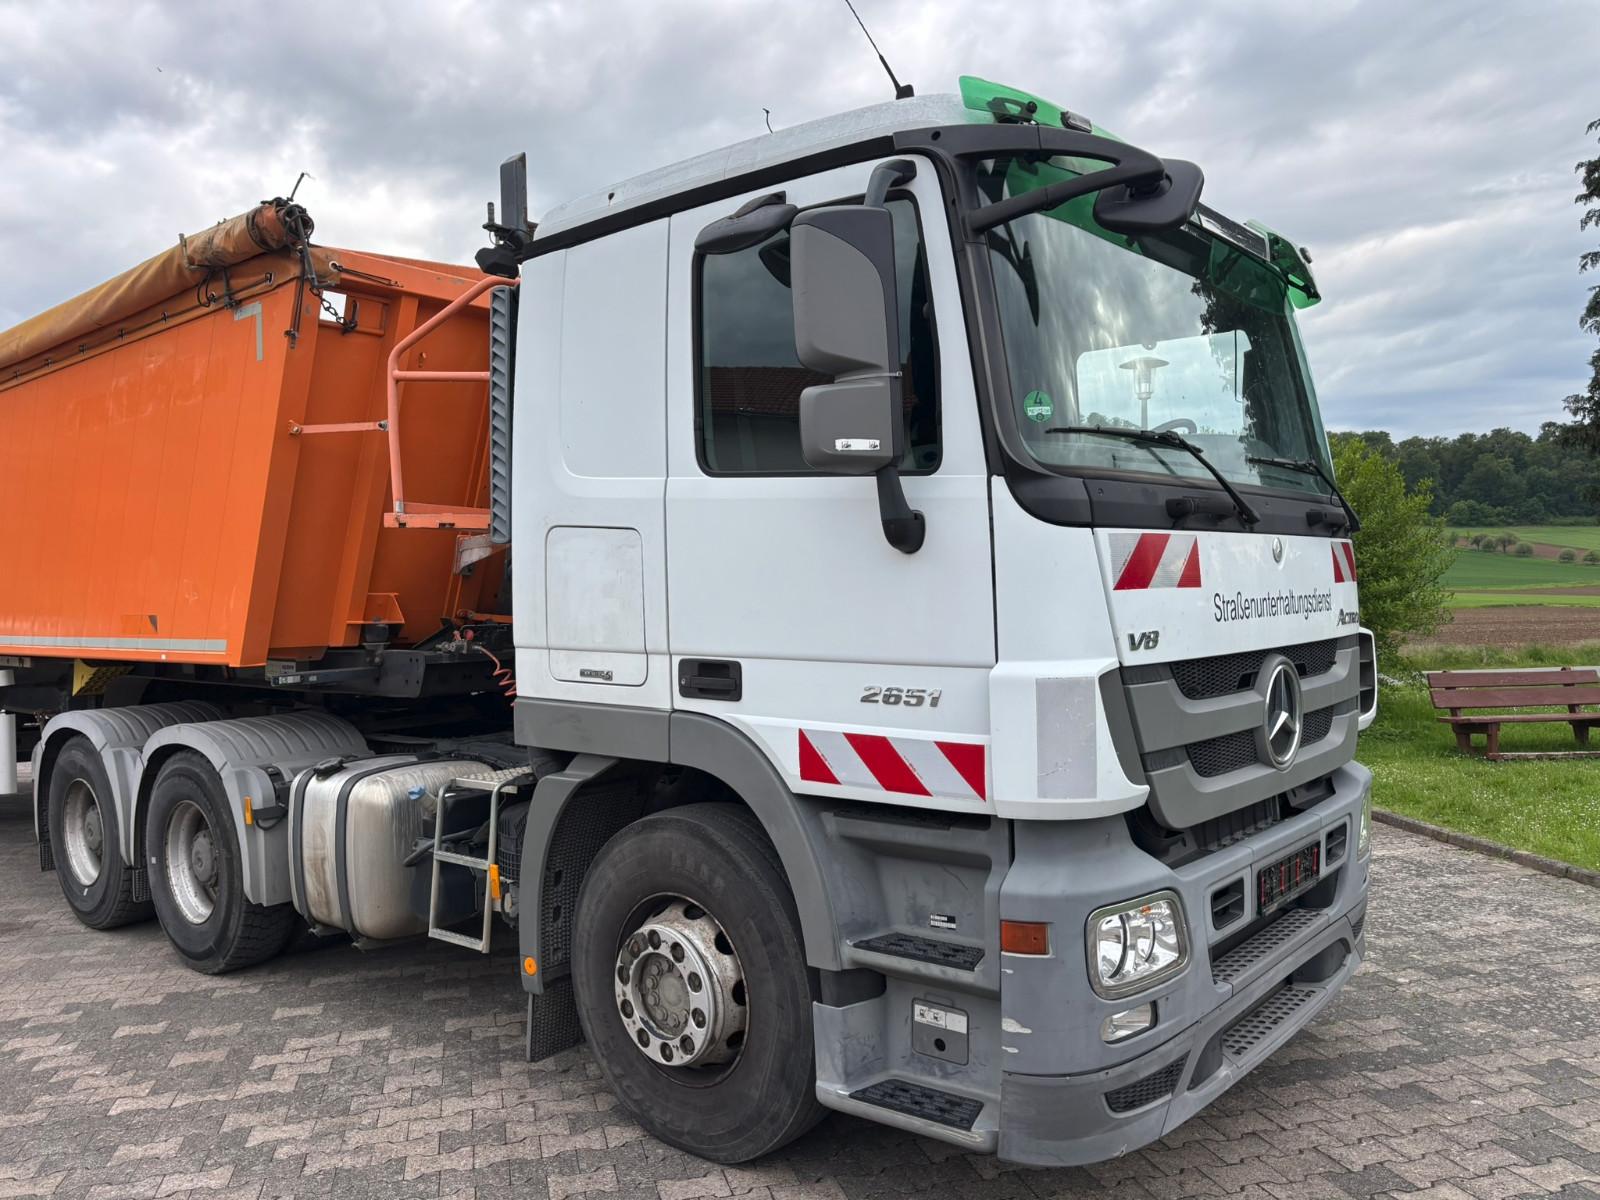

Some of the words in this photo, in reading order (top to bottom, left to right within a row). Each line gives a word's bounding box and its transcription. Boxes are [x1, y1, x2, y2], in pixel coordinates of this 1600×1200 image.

[1034, 391, 1043, 406] 4
[1213, 588, 1332, 622] Straßenunterhaltungsdienst
[1127, 630, 1160, 651] V8
[860, 685, 942, 708] 2651
